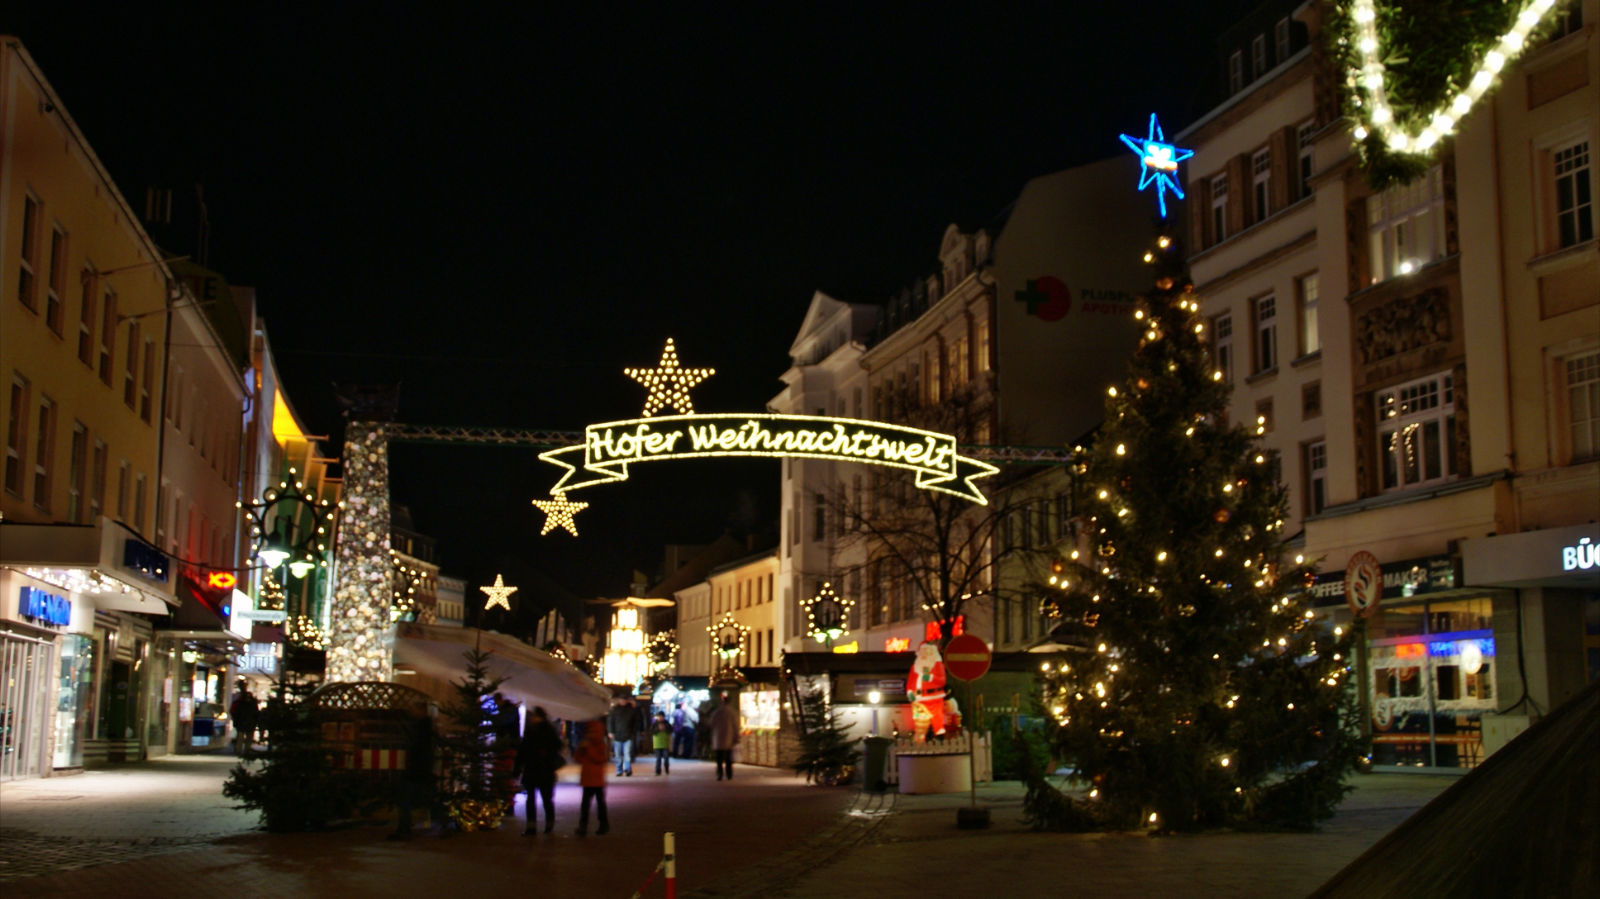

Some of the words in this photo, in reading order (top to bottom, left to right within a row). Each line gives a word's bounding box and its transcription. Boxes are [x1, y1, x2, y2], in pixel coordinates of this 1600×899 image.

[588, 424, 683, 460] Hofer
[688, 420, 954, 469] Weihnachtswelt
[1383, 567, 1428, 589] MAKER
